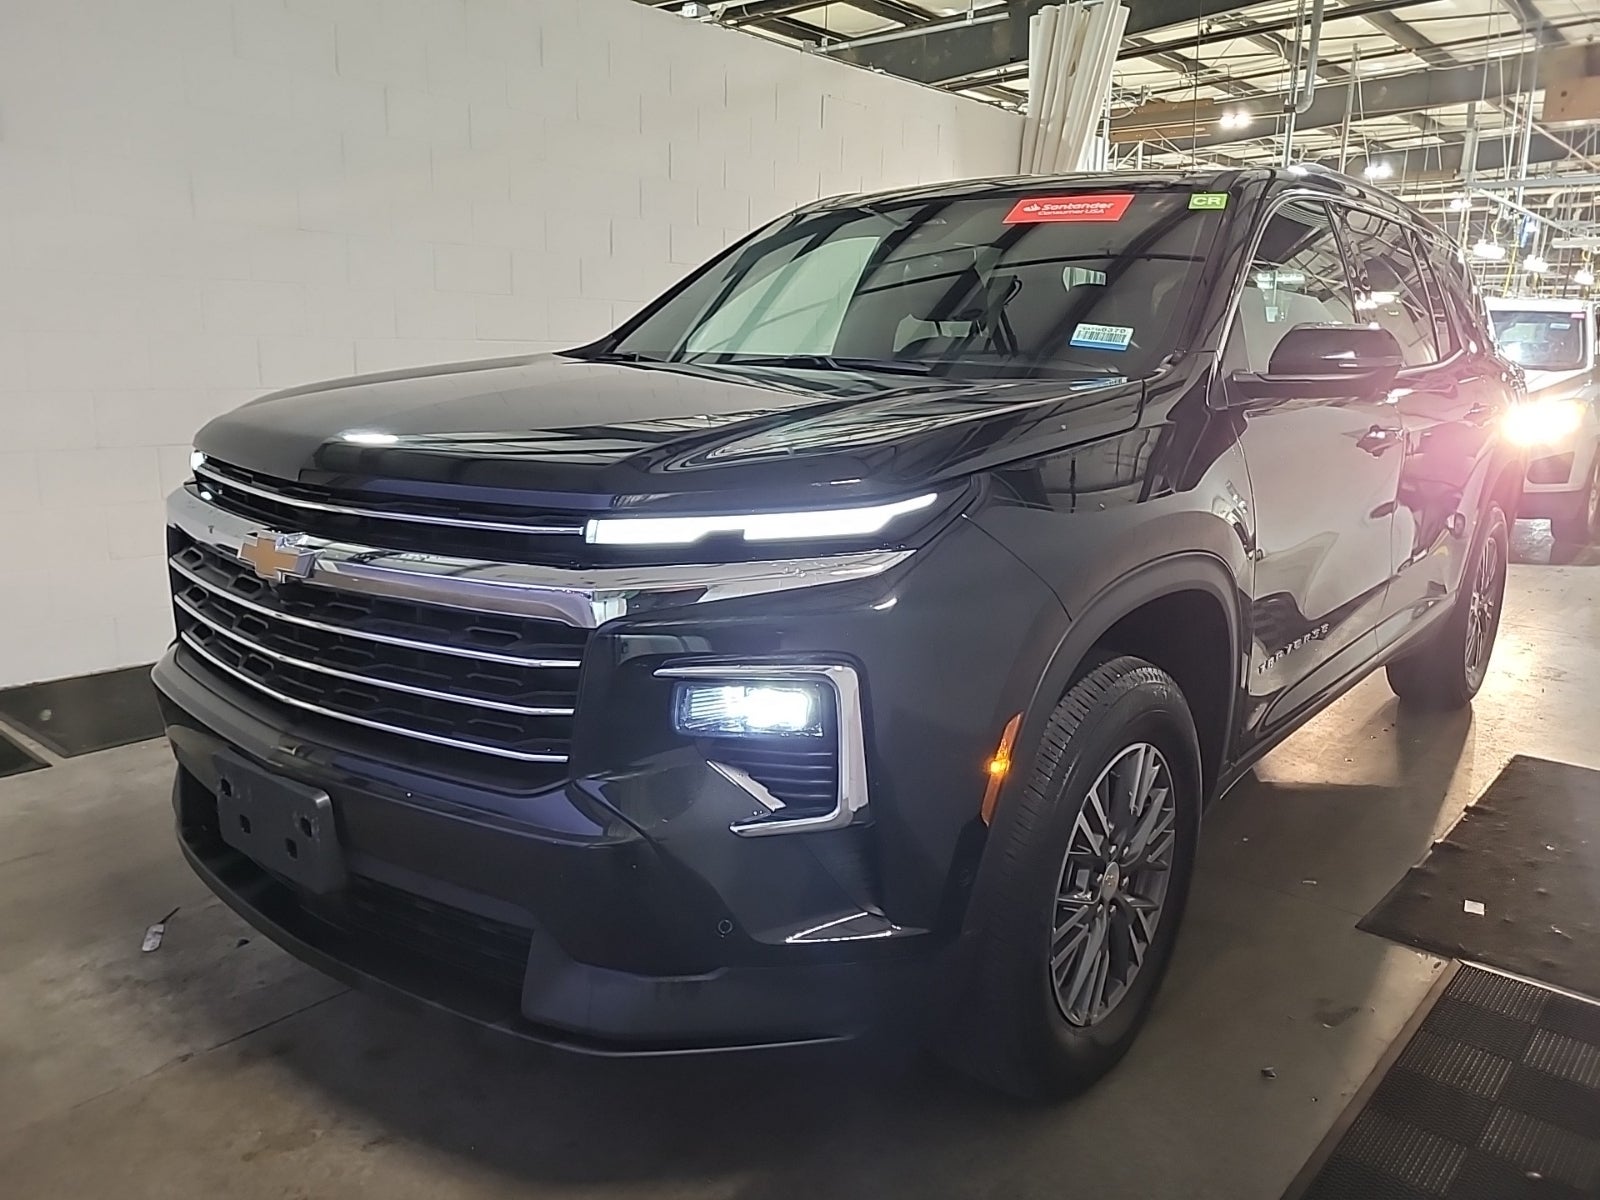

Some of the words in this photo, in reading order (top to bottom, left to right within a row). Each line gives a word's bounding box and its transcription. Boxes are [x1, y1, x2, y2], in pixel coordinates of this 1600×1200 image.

[1193, 197, 1222, 206] CR
[1041, 202, 1114, 211] Santander
[1259, 623, 1329, 673] TRAVERSE
